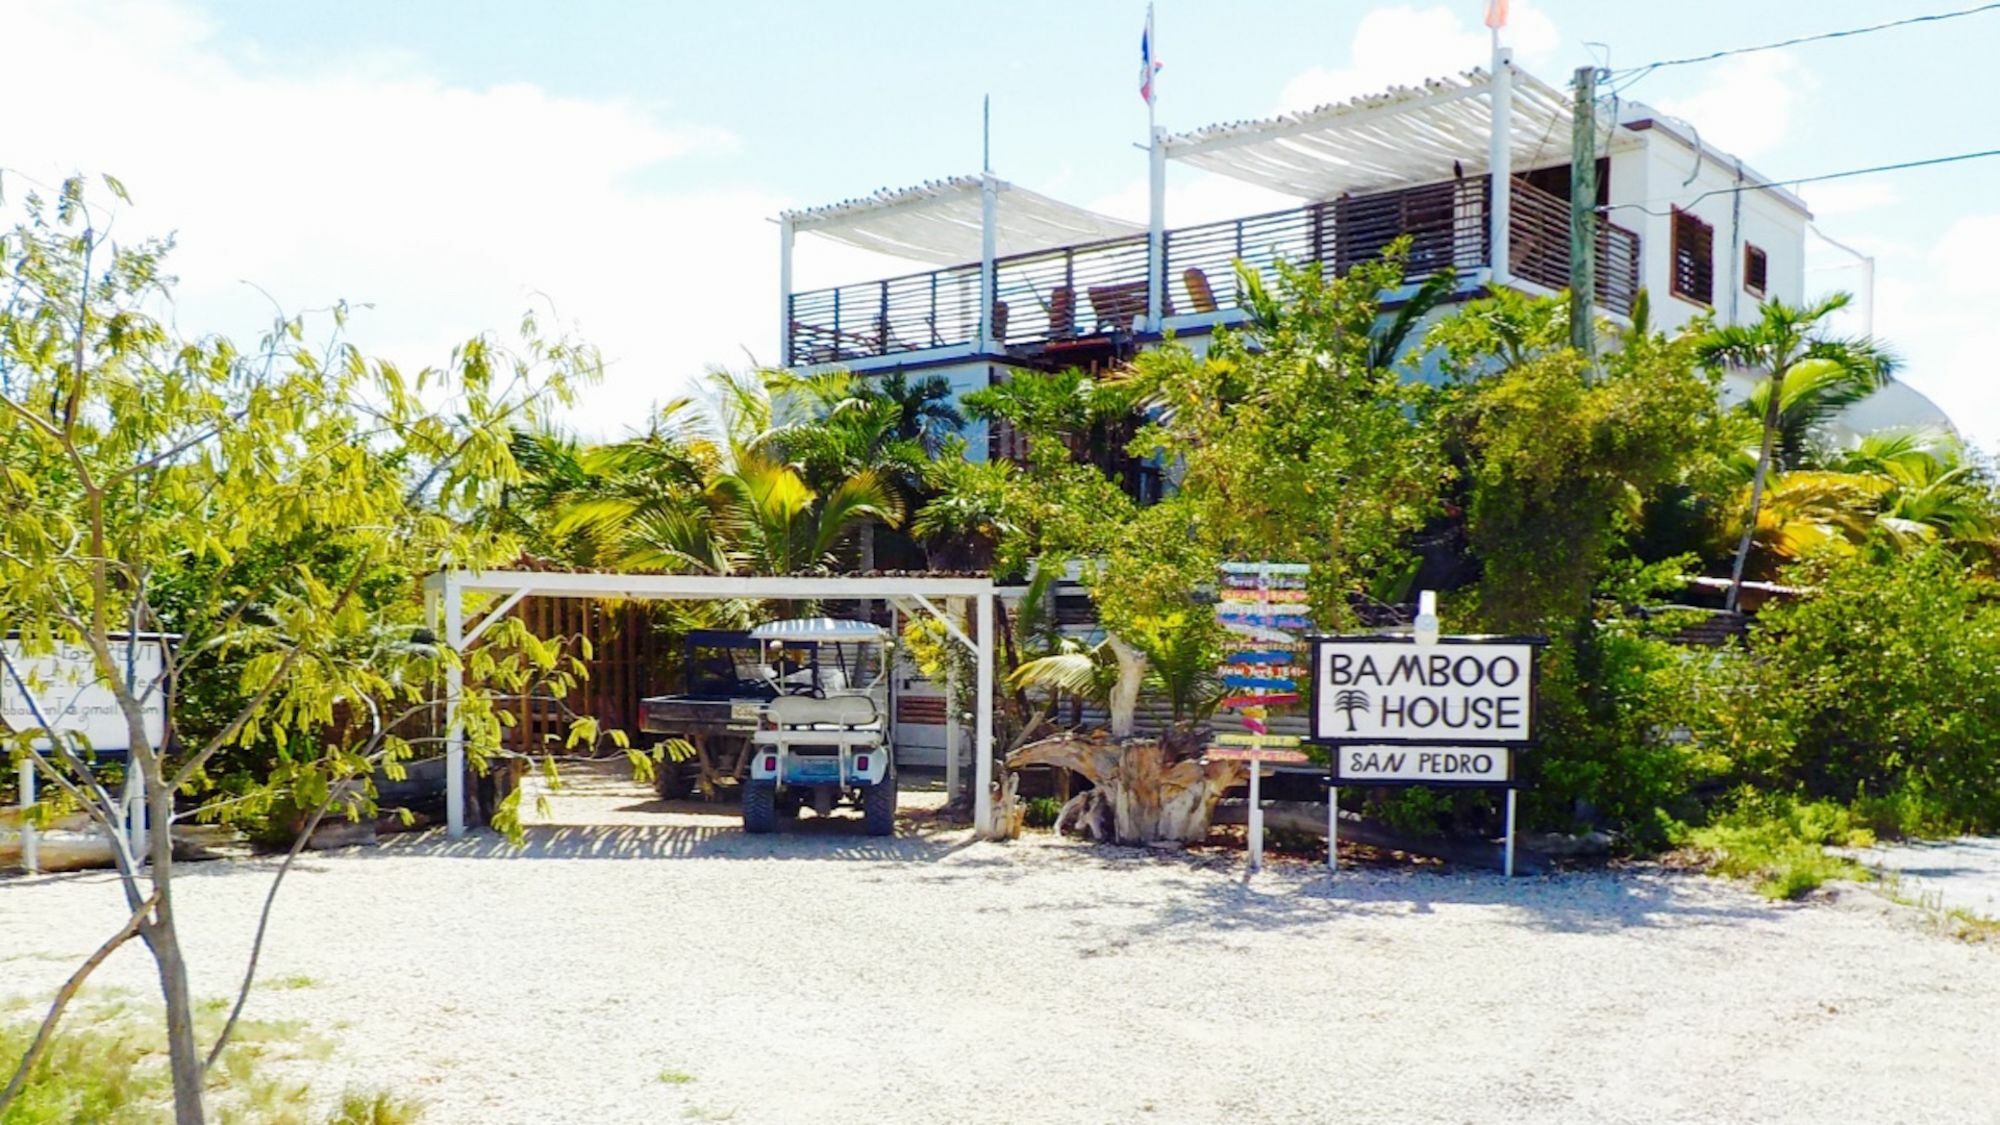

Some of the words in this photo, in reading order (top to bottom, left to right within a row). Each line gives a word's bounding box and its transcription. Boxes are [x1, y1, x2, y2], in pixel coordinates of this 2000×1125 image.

[1330, 654, 1519, 688] BAMBOO
[1381, 695, 1521, 729] HOUSE
[1350, 752, 1406, 772] SAN
[1418, 752, 1493, 774] PEDRO
